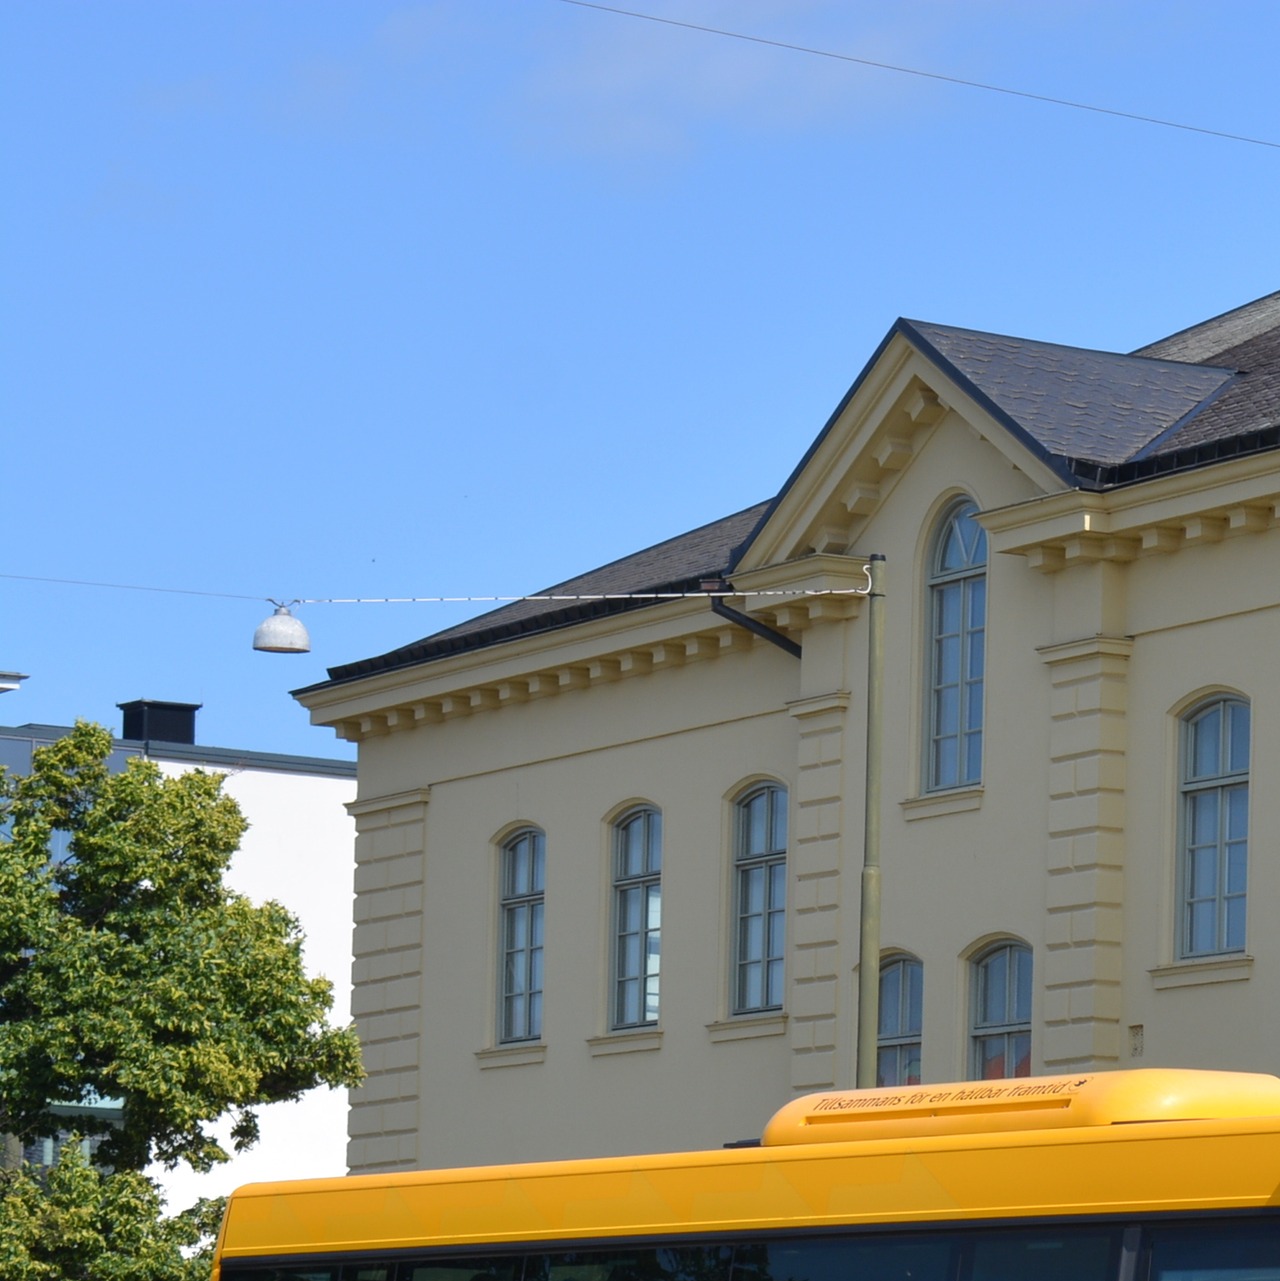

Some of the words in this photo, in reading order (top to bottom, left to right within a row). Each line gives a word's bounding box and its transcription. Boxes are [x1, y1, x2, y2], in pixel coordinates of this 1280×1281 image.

[813, 1096, 905, 1111] Tillsammans
[905, 1092, 931, 1105] för
[929, 1091, 951, 1102] en
[951, 1087, 1008, 1101] hållbar
[1007, 1081, 1071, 1097] framtid
